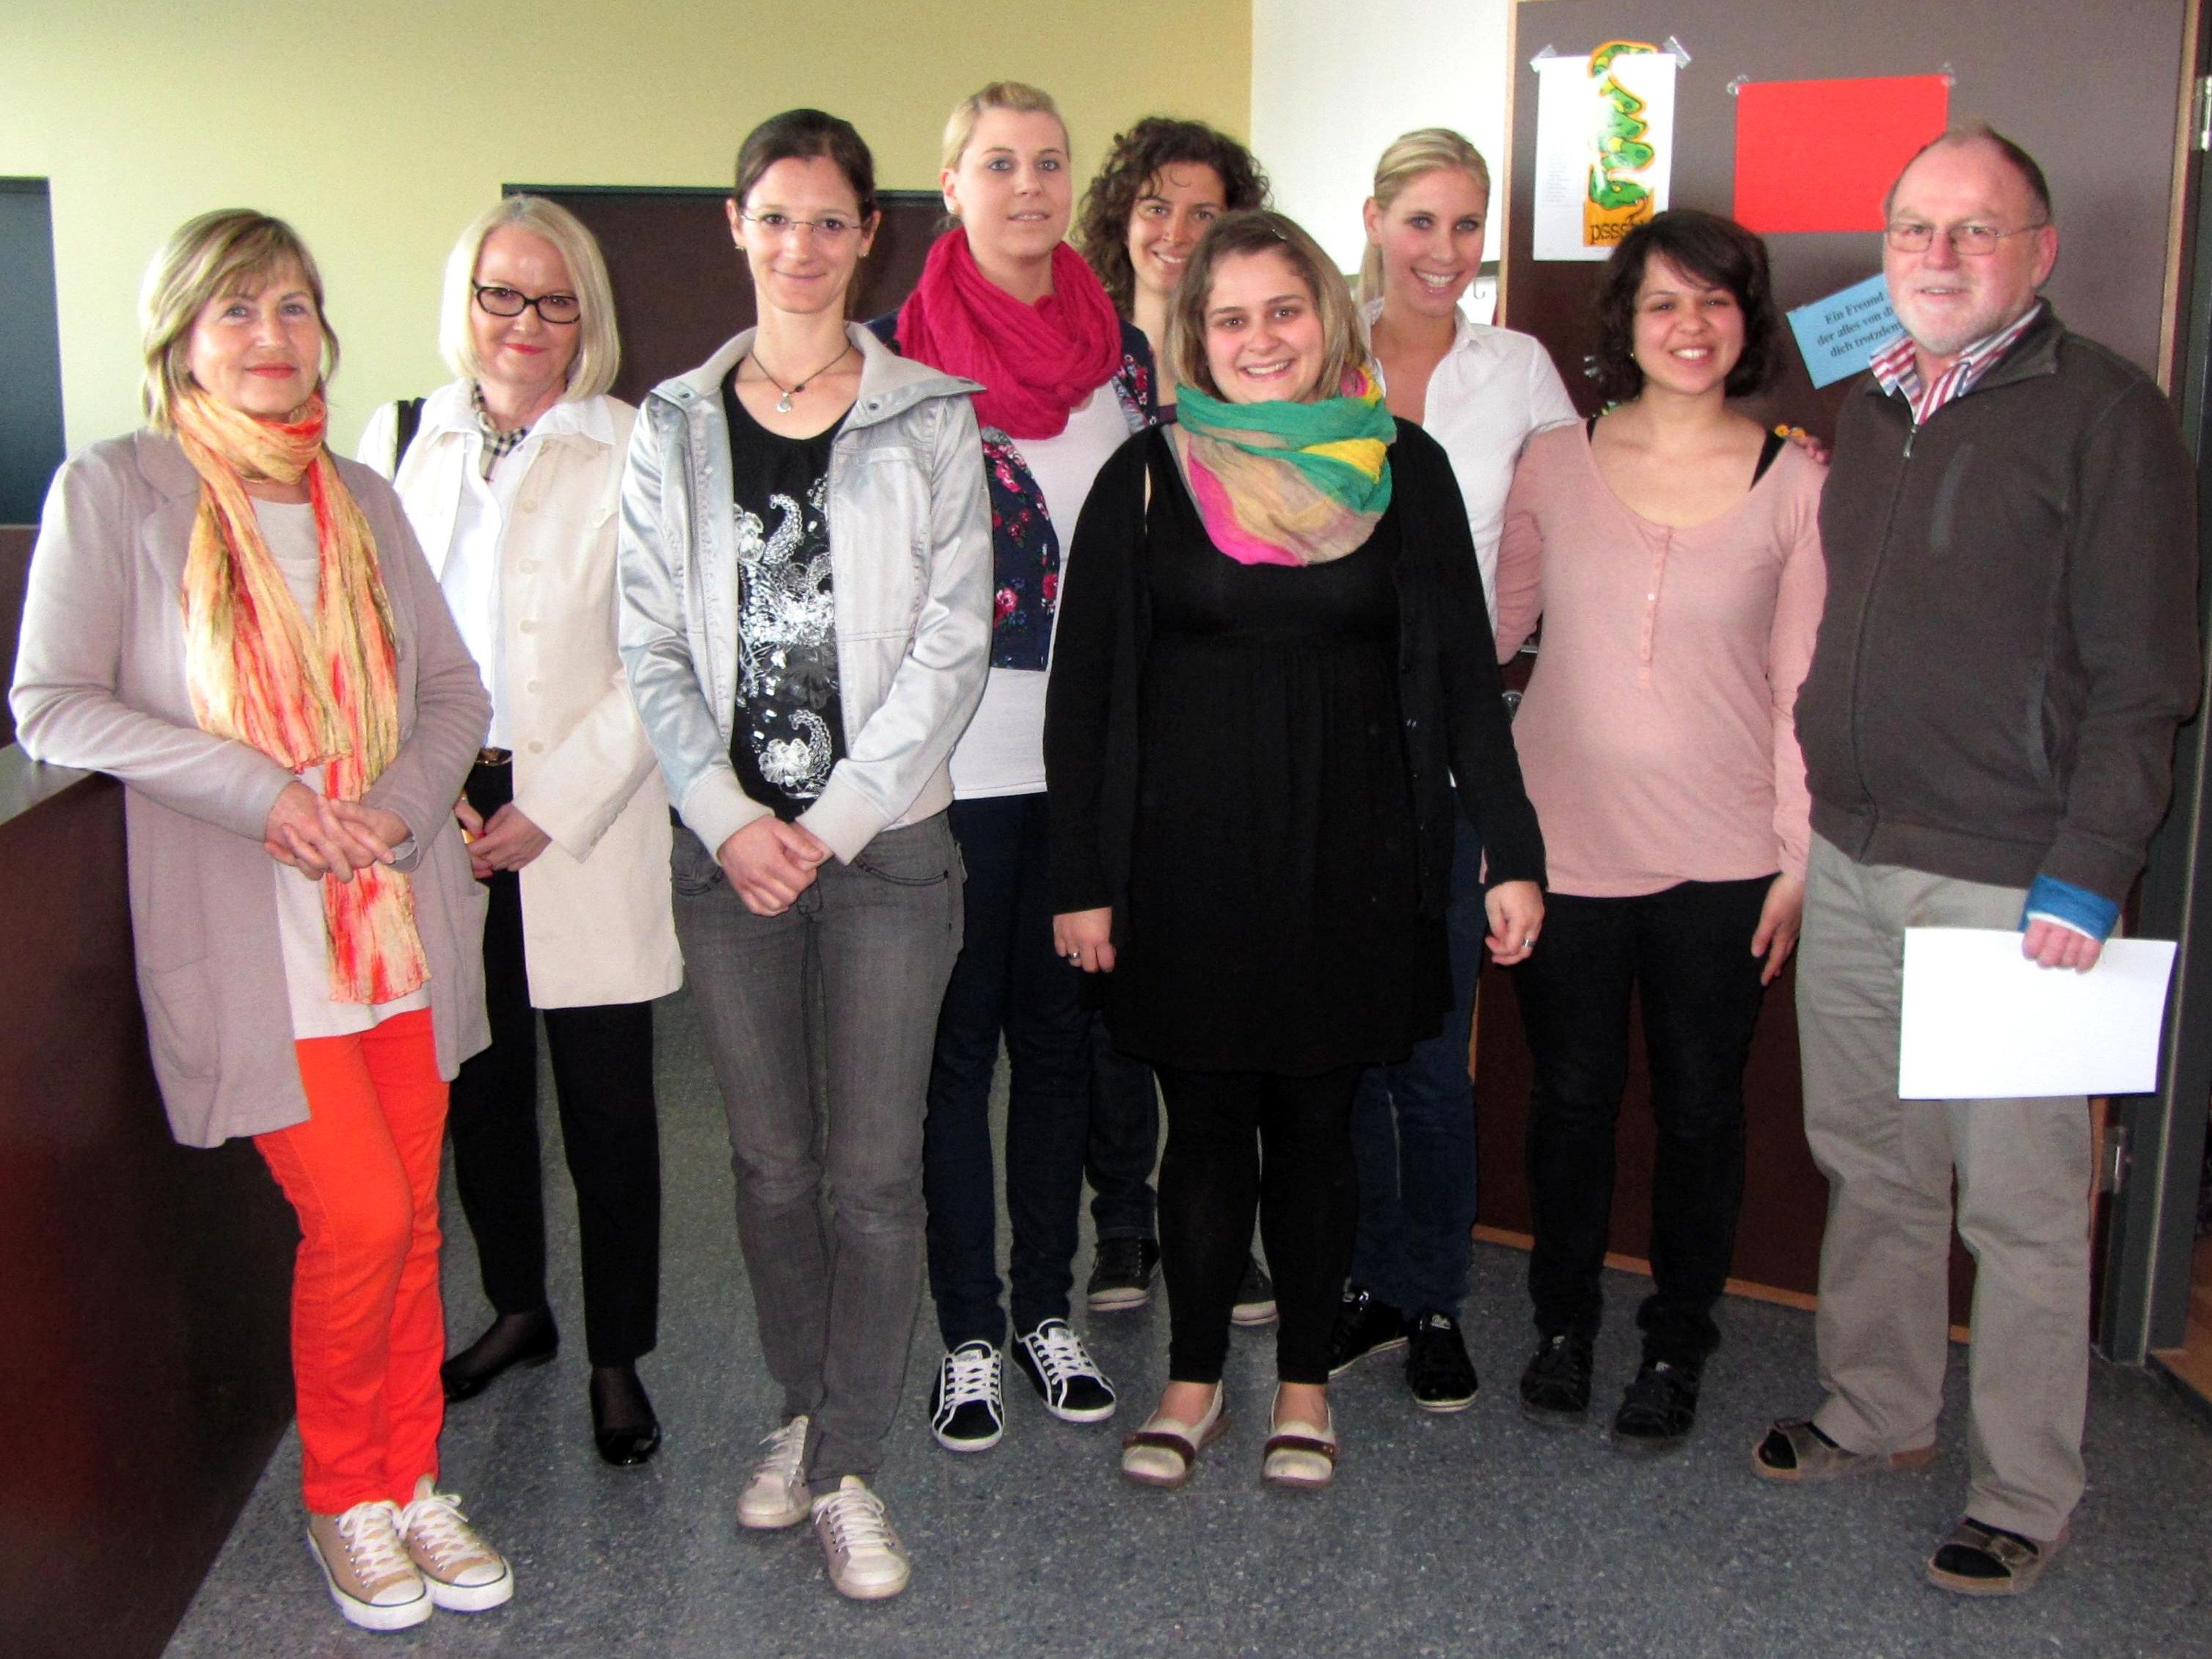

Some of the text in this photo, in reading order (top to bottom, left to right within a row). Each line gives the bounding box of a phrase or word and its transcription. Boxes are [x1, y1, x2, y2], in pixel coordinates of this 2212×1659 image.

[1825, 312, 1844, 325] Ein
[1817, 332, 1835, 346] der
[1837, 321, 1861, 335] alles
[1862, 313, 1882, 326] von
[1830, 340, 1853, 357] dich
